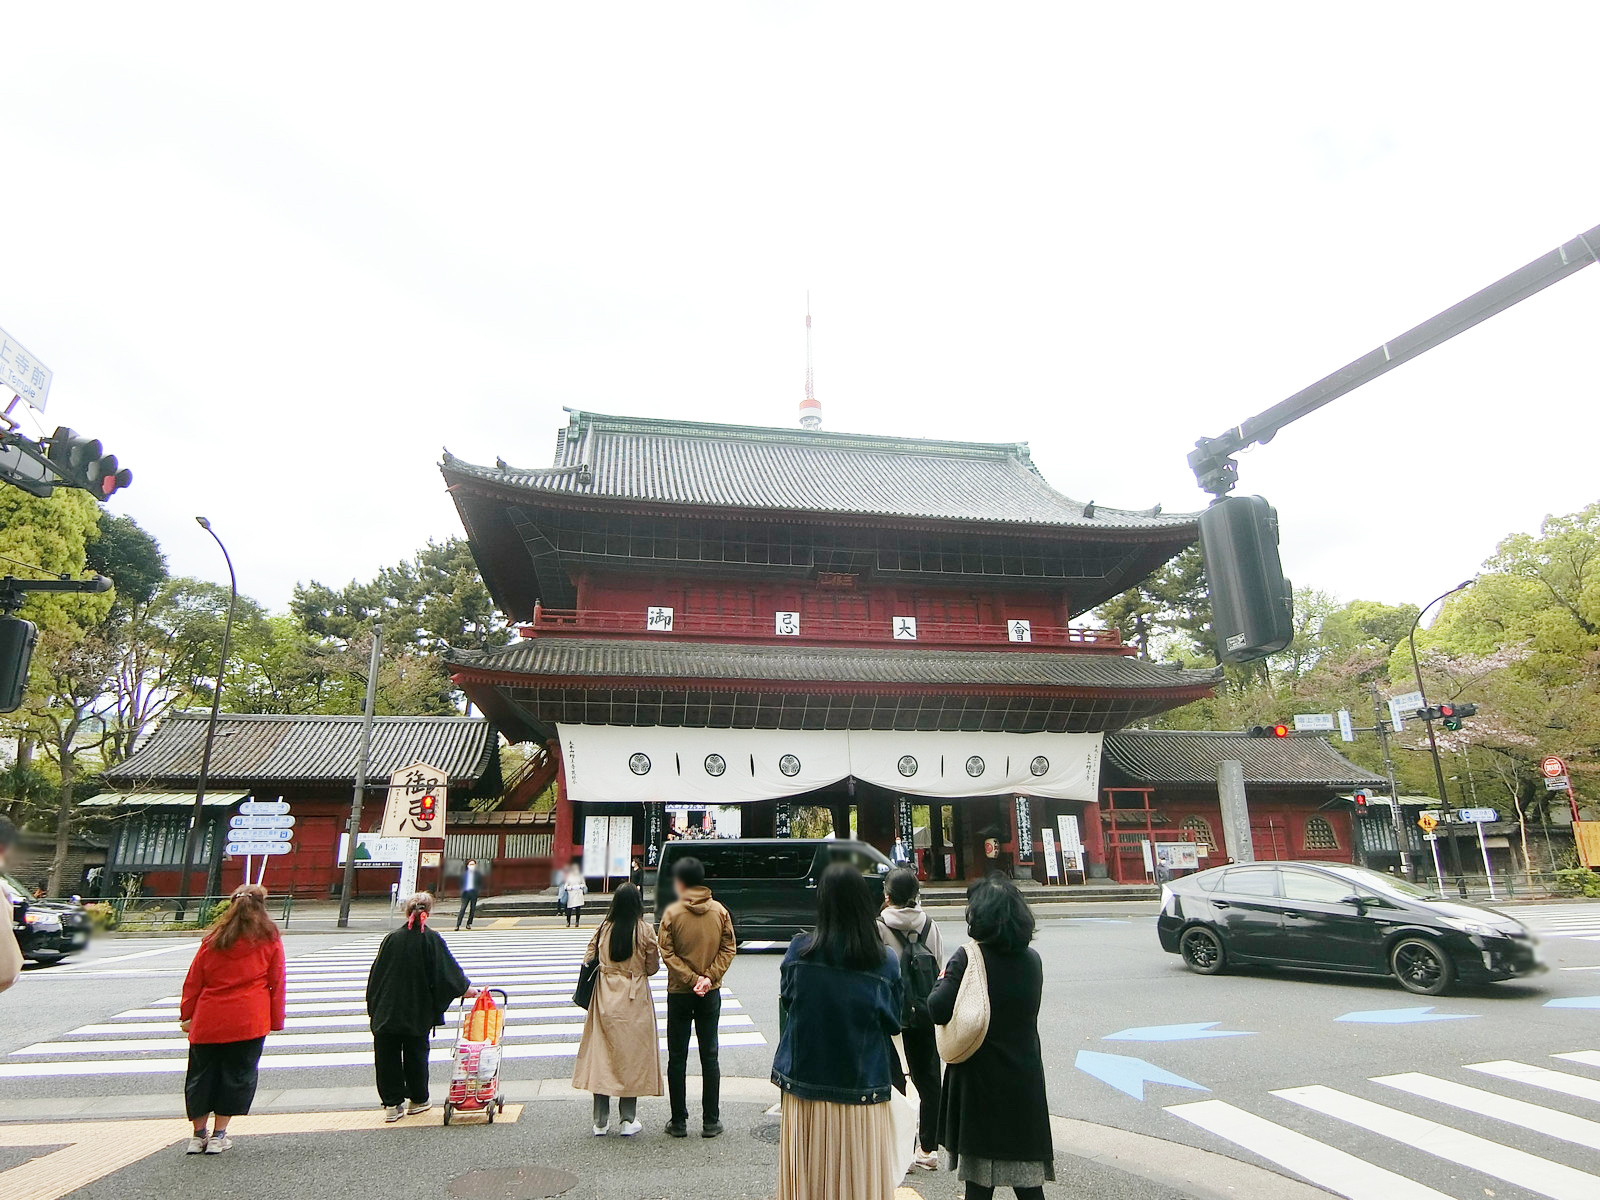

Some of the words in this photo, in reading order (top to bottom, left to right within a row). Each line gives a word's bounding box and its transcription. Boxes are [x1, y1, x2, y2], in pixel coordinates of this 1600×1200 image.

[9, 368, 36, 398] Temple
[649, 608, 672, 630] 御
[779, 613, 798, 634] 忌
[897, 618, 915, 638] 大
